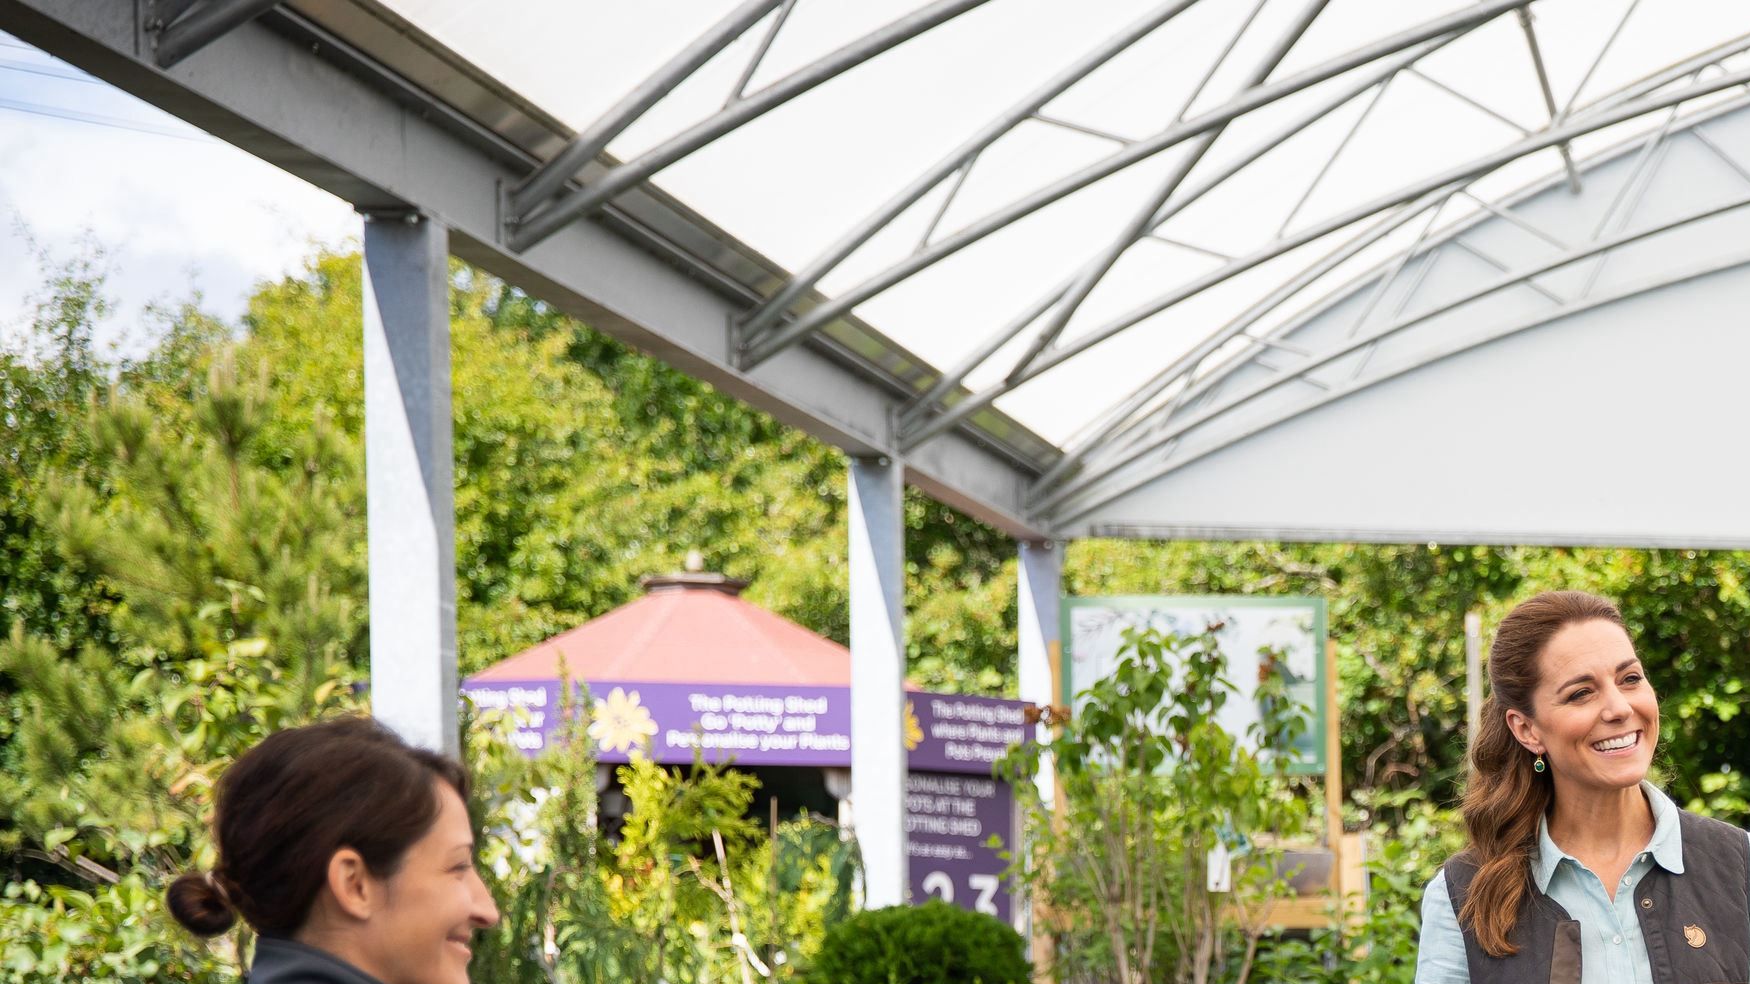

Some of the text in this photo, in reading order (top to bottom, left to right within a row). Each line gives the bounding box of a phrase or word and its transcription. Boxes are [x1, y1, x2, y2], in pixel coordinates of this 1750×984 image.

[689, 694, 828, 715] The Potting Shed
[931, 699, 1025, 725] The Potting Shed
[701, 712, 728, 730] Go
[783, 714, 816, 732] and
[666, 729, 850, 751] Peronalise your Plants
[952, 797, 976, 817] THE
[949, 817, 982, 837] SHED
